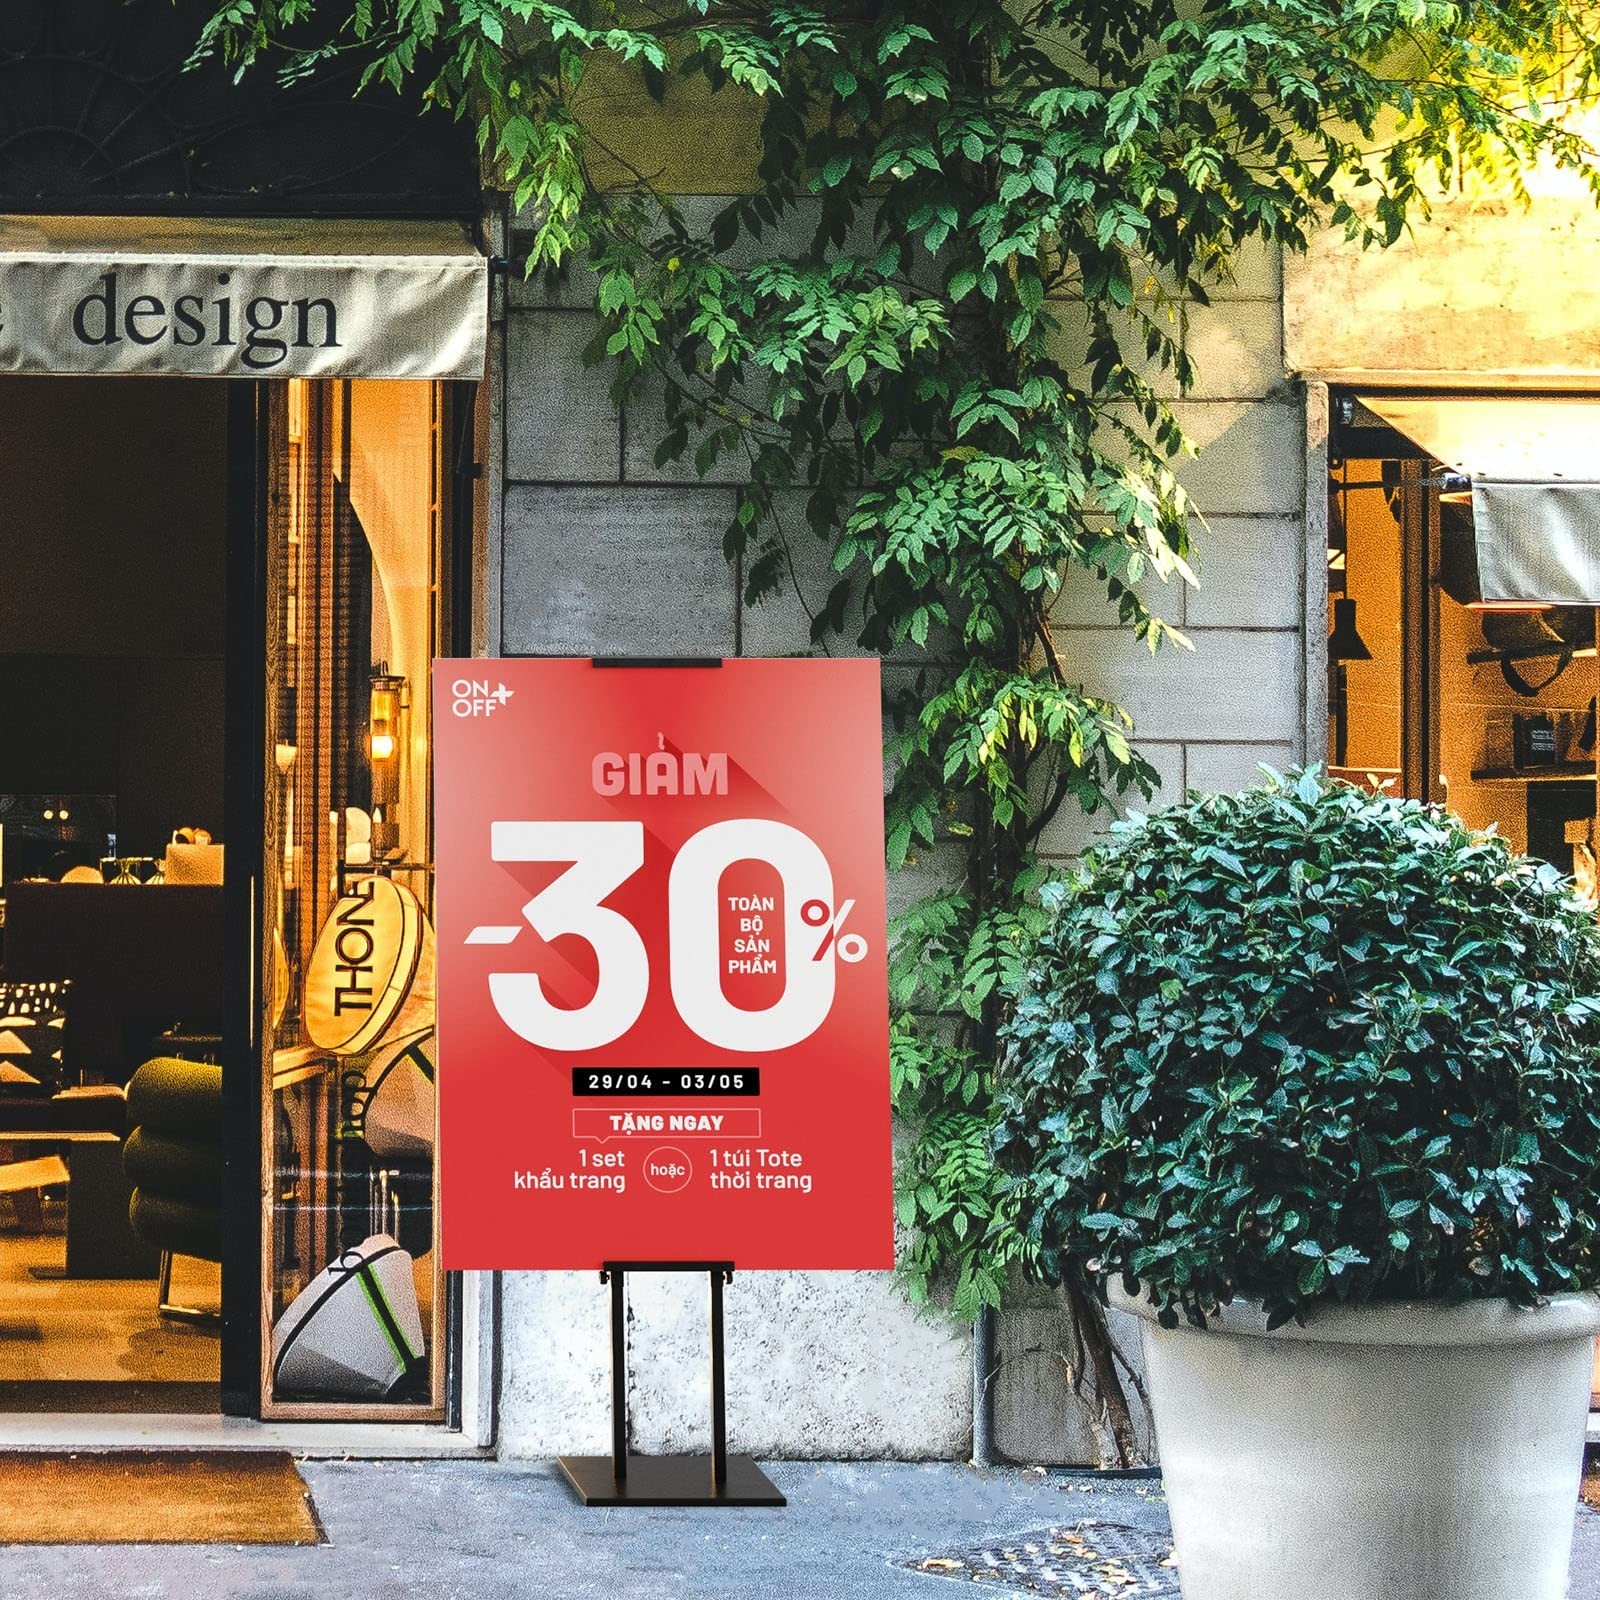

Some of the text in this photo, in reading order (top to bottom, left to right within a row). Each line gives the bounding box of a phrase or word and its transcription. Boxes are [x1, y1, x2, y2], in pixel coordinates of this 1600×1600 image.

[72, 273, 343, 369] design
[451, 679, 489, 699] ON
[451, 699, 497, 718] OFF
[591, 731, 729, 797] GIẢM
[727, 893, 775, 912] TOÀN
[740, 915, 764, 937] BỘ
[333, 860, 375, 1017] THONET
[734, 933, 770, 953] SẢN
[728, 953, 777, 974] PHẨM
[588, 1074, 652, 1089] 29/04
[680, 1074, 744, 1089] 03/05
[609, 1112, 724, 1135] TẶNG NGAY
[579, 1148, 625, 1167] 1 set
[709, 1148, 803, 1167] 1 túi Tote
[514, 1167, 626, 1194] khẩu trang
[650, 1163, 685, 1179] hoặc
[709, 1170, 812, 1194] thời trang
